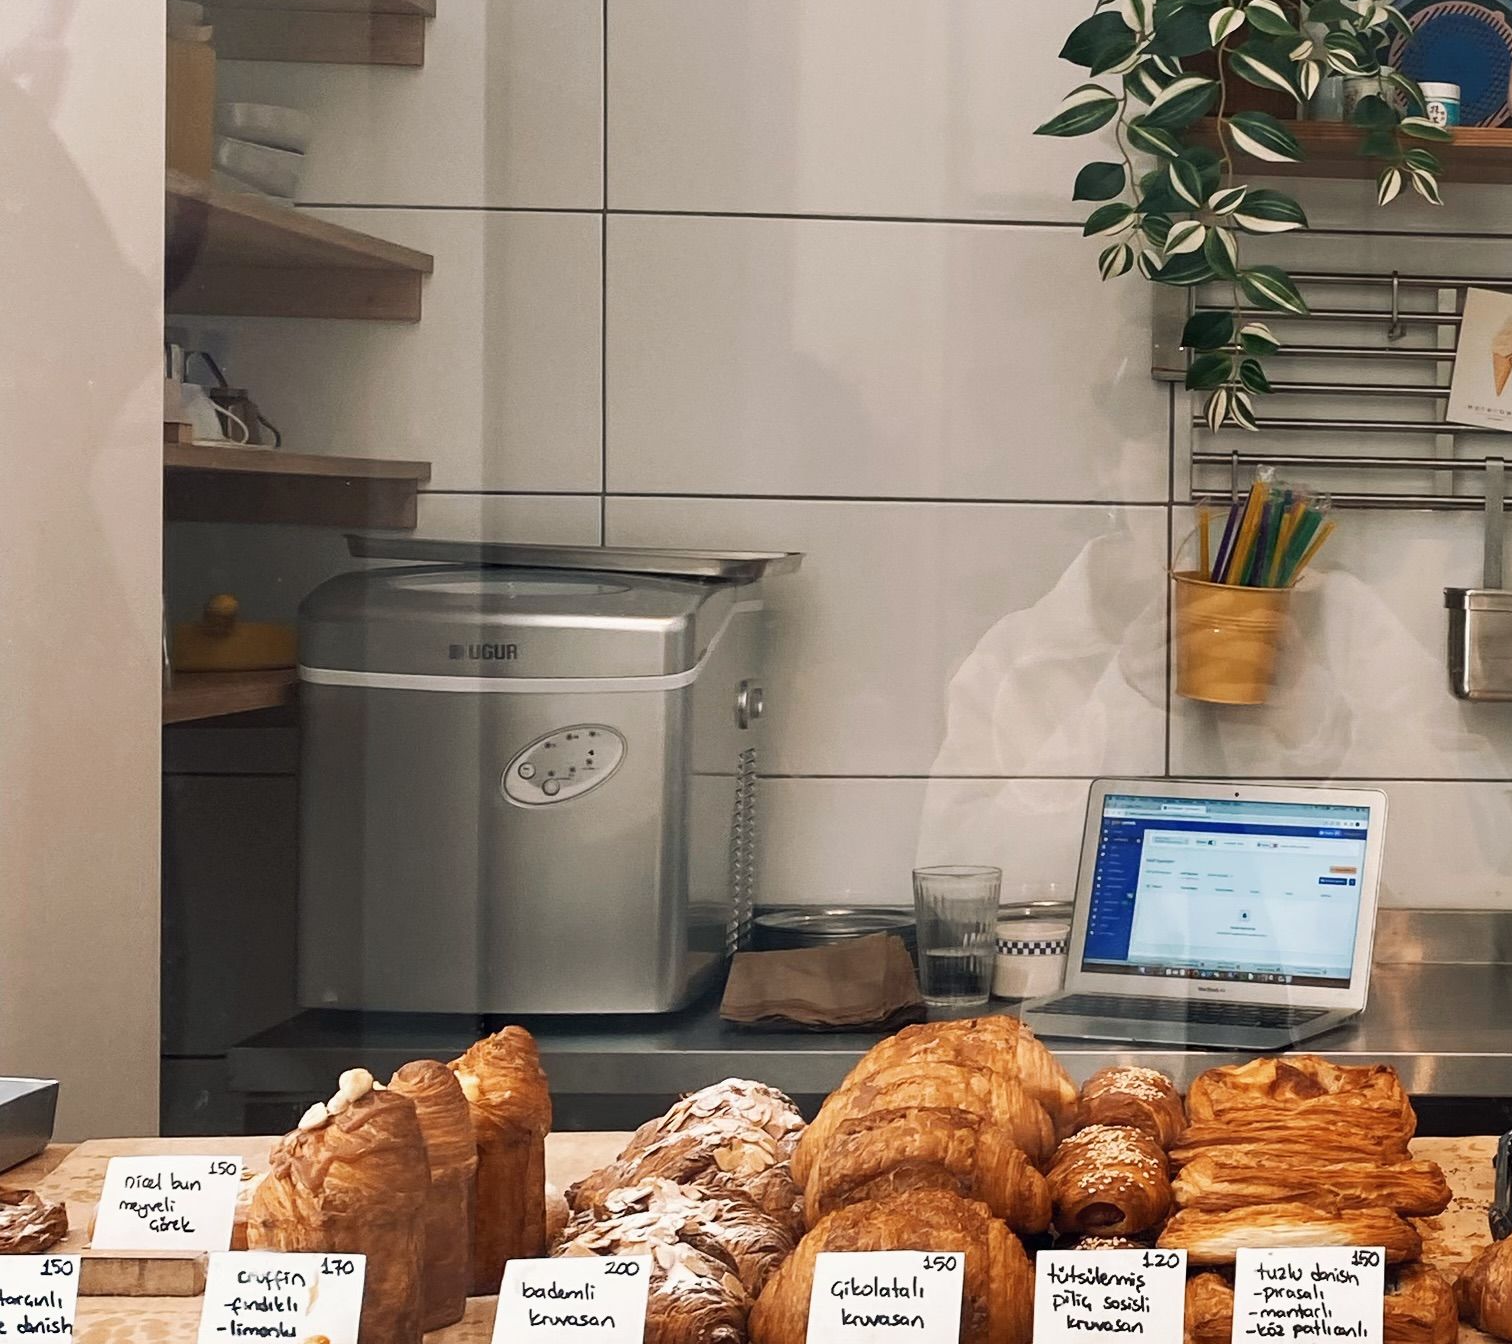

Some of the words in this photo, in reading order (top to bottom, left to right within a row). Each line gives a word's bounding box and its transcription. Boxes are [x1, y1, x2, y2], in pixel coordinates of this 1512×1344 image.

[208, 1161, 237, 1175] 150
[170, 1172, 201, 1191] bun
[40, 1259, 74, 1276] 150
[321, 1257, 355, 1276] 170
[923, 1255, 957, 1272] 150
[1142, 1251, 1180, 1269] 120
[1351, 1250, 1380, 1267] 150
[604, 1261, 640, 1276] 200
[522, 1281, 596, 1301] bademli
[1103, 1295, 1150, 1313] sosisli
[17, 1314, 74, 1336] danish
[528, 1308, 616, 1328] kruvasan
[841, 1308, 925, 1329] kruvasan
[1066, 1314, 1144, 1334] kruvasan
